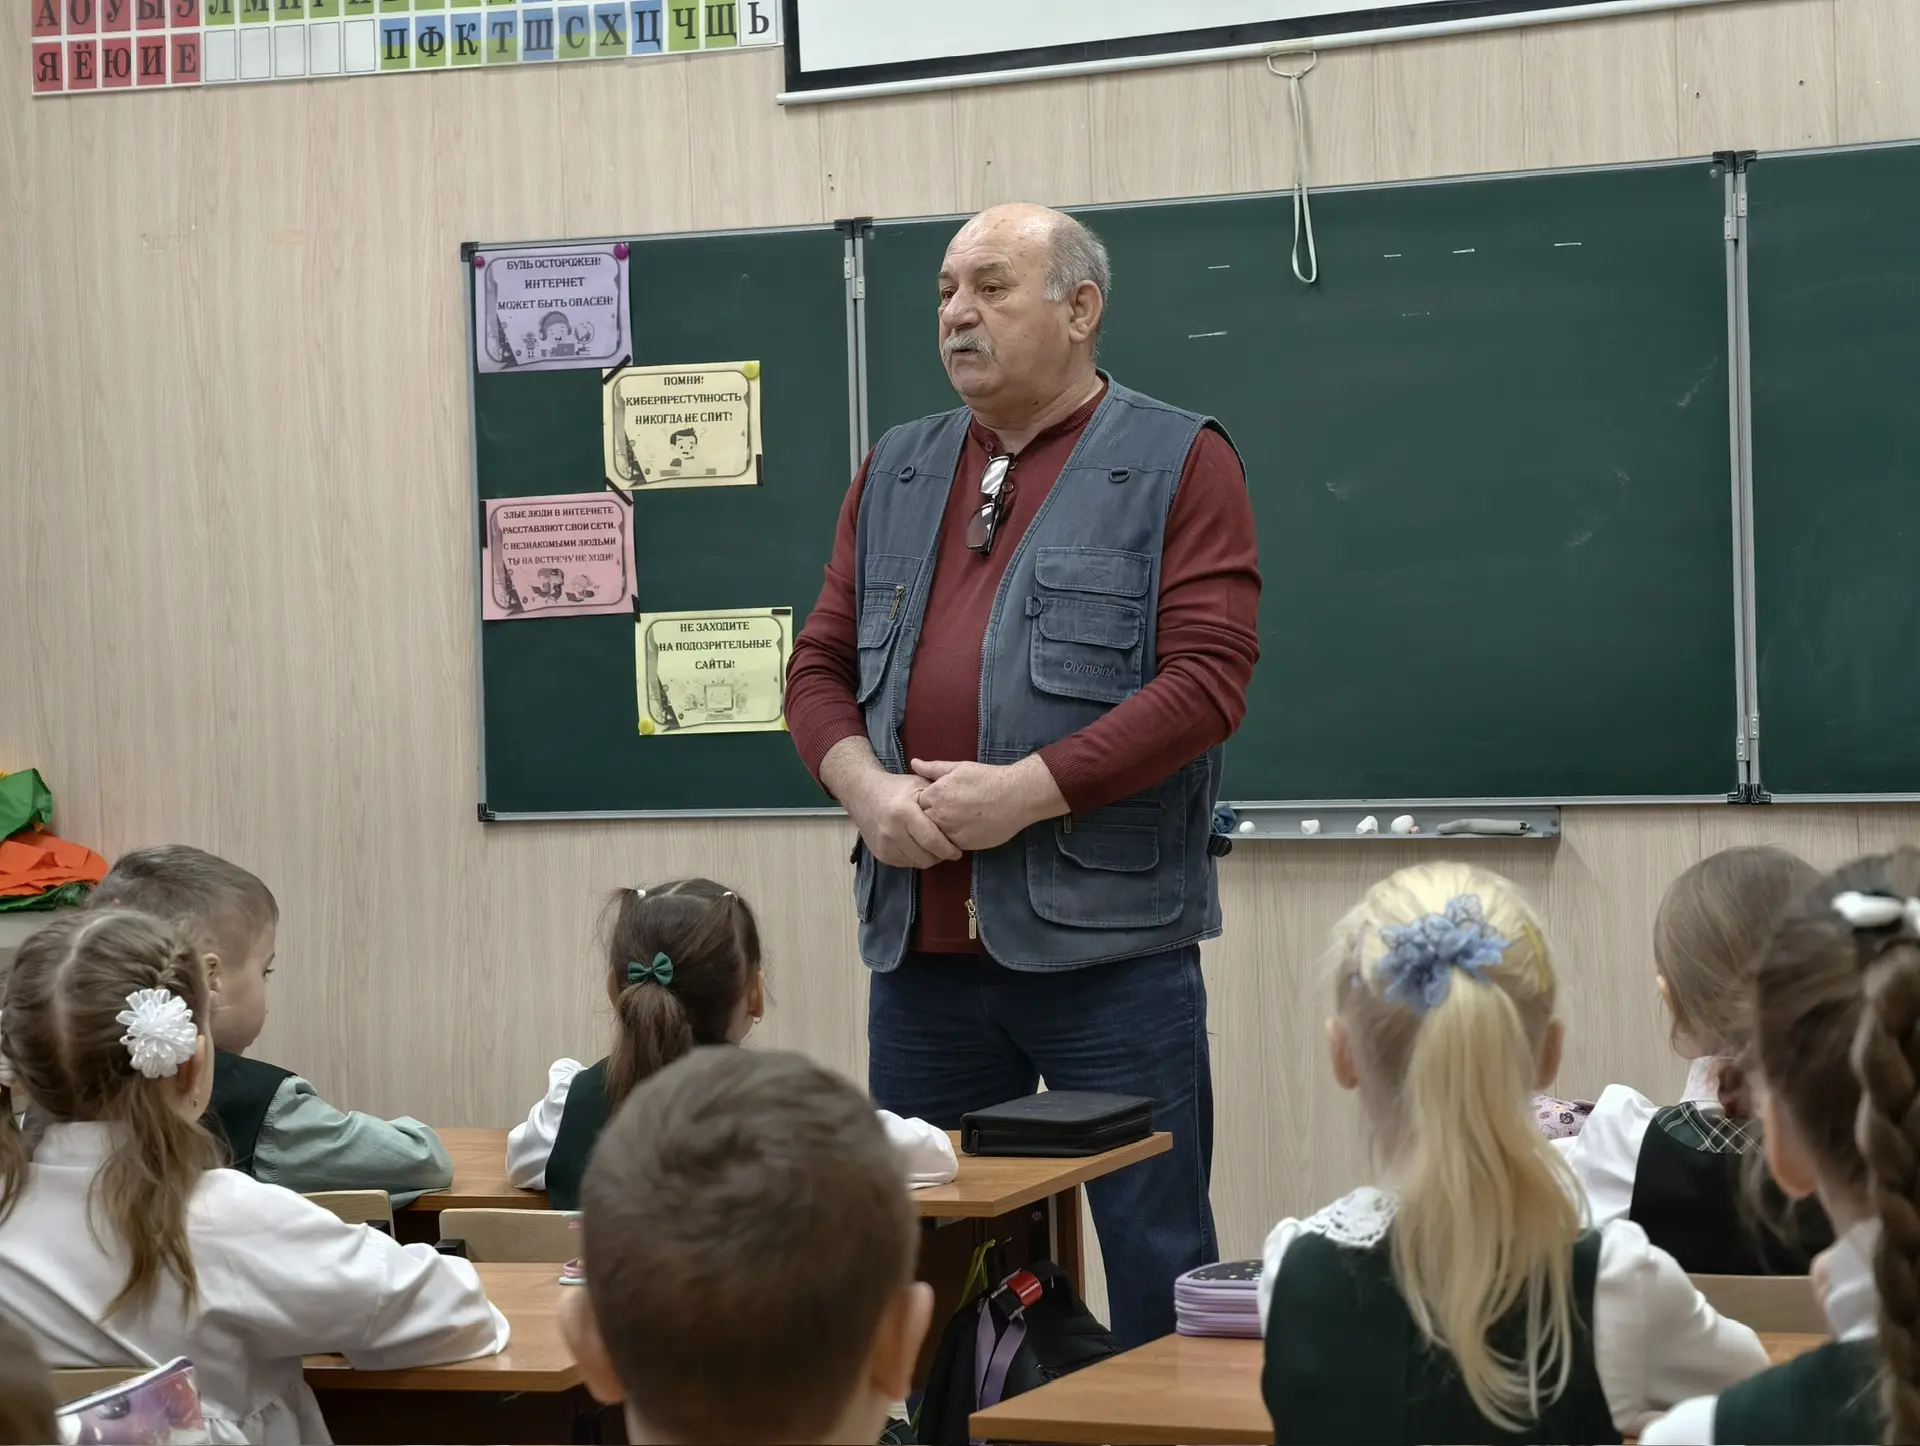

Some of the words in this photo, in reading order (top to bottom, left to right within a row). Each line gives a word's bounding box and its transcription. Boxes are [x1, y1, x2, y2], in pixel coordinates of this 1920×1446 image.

[37, 52, 60, 82] Я
[74, 43, 92, 80] Ё
[103, 47, 131, 78] Ю
[140, 45, 164, 76] И
[177, 43, 196, 74] Е
[383, 28, 408, 60] П
[418, 26, 445, 57] Ф
[455, 22, 478, 56] К
[492, 21, 513, 53] Т
[523, 18, 553, 52] Ш
[566, 15, 585, 49] С
[598, 13, 624, 46] Х
[634, 9, 661, 50] Ц
[672, 7, 696, 40] Ч
[705, 3, 737, 39] Щ
[748, 1, 770, 35] Ь
[507, 259, 533, 270] БУДЬ
[535, 257, 601, 269] ОСТОРОЖЕН!
[525, 277, 585, 289] ИНТЕРНЕТ
[497, 299, 536, 310] МОЖЕТ
[537, 298, 567, 309] БЫТЬ
[569, 296, 613, 307] ОПАСЕН!
[664, 376, 704, 386] ПОМНИ!
[626, 392, 742, 406] КИБЕРПРЕСТУПНОСТЬ
[635, 413, 683, 425] НИКОГДА
[684, 413, 698, 423] НЕ
[700, 411, 733, 422] СПИТ!
[504, 510, 527, 519] ЗЛЫЕ
[528, 509, 553, 518] ЛЮДИ
[555, 508, 561, 517] В
[562, 507, 614, 516] ИНТЕРНЕТЕ
[503, 524, 564, 534] РАССТАВЛЯЮТ
[565, 522, 590, 531] СВОИ
[591, 521, 616, 530] СЕТИ.
[503, 542, 510, 550] С
[511, 538, 577, 550] НЕЗНАКОМЫМИ
[578, 537, 616, 547] ЛЮДЬМИ
[507, 557, 520, 565] ТЫ
[522, 556, 533, 564] НА
[535, 554, 574, 564] ВСТРЕЧУ
[575, 554, 588, 562] НЕ
[588, 553, 614, 562] ХОДИ!
[680, 623, 694, 632] НЕ
[696, 621, 750, 631] ЗАХОДИТЕ
[659, 642, 674, 651] НА
[676, 639, 772, 651] ПОДОЗРИТЕЛЬНЫЕ
[695, 659, 735, 670] САЙТЫ!
